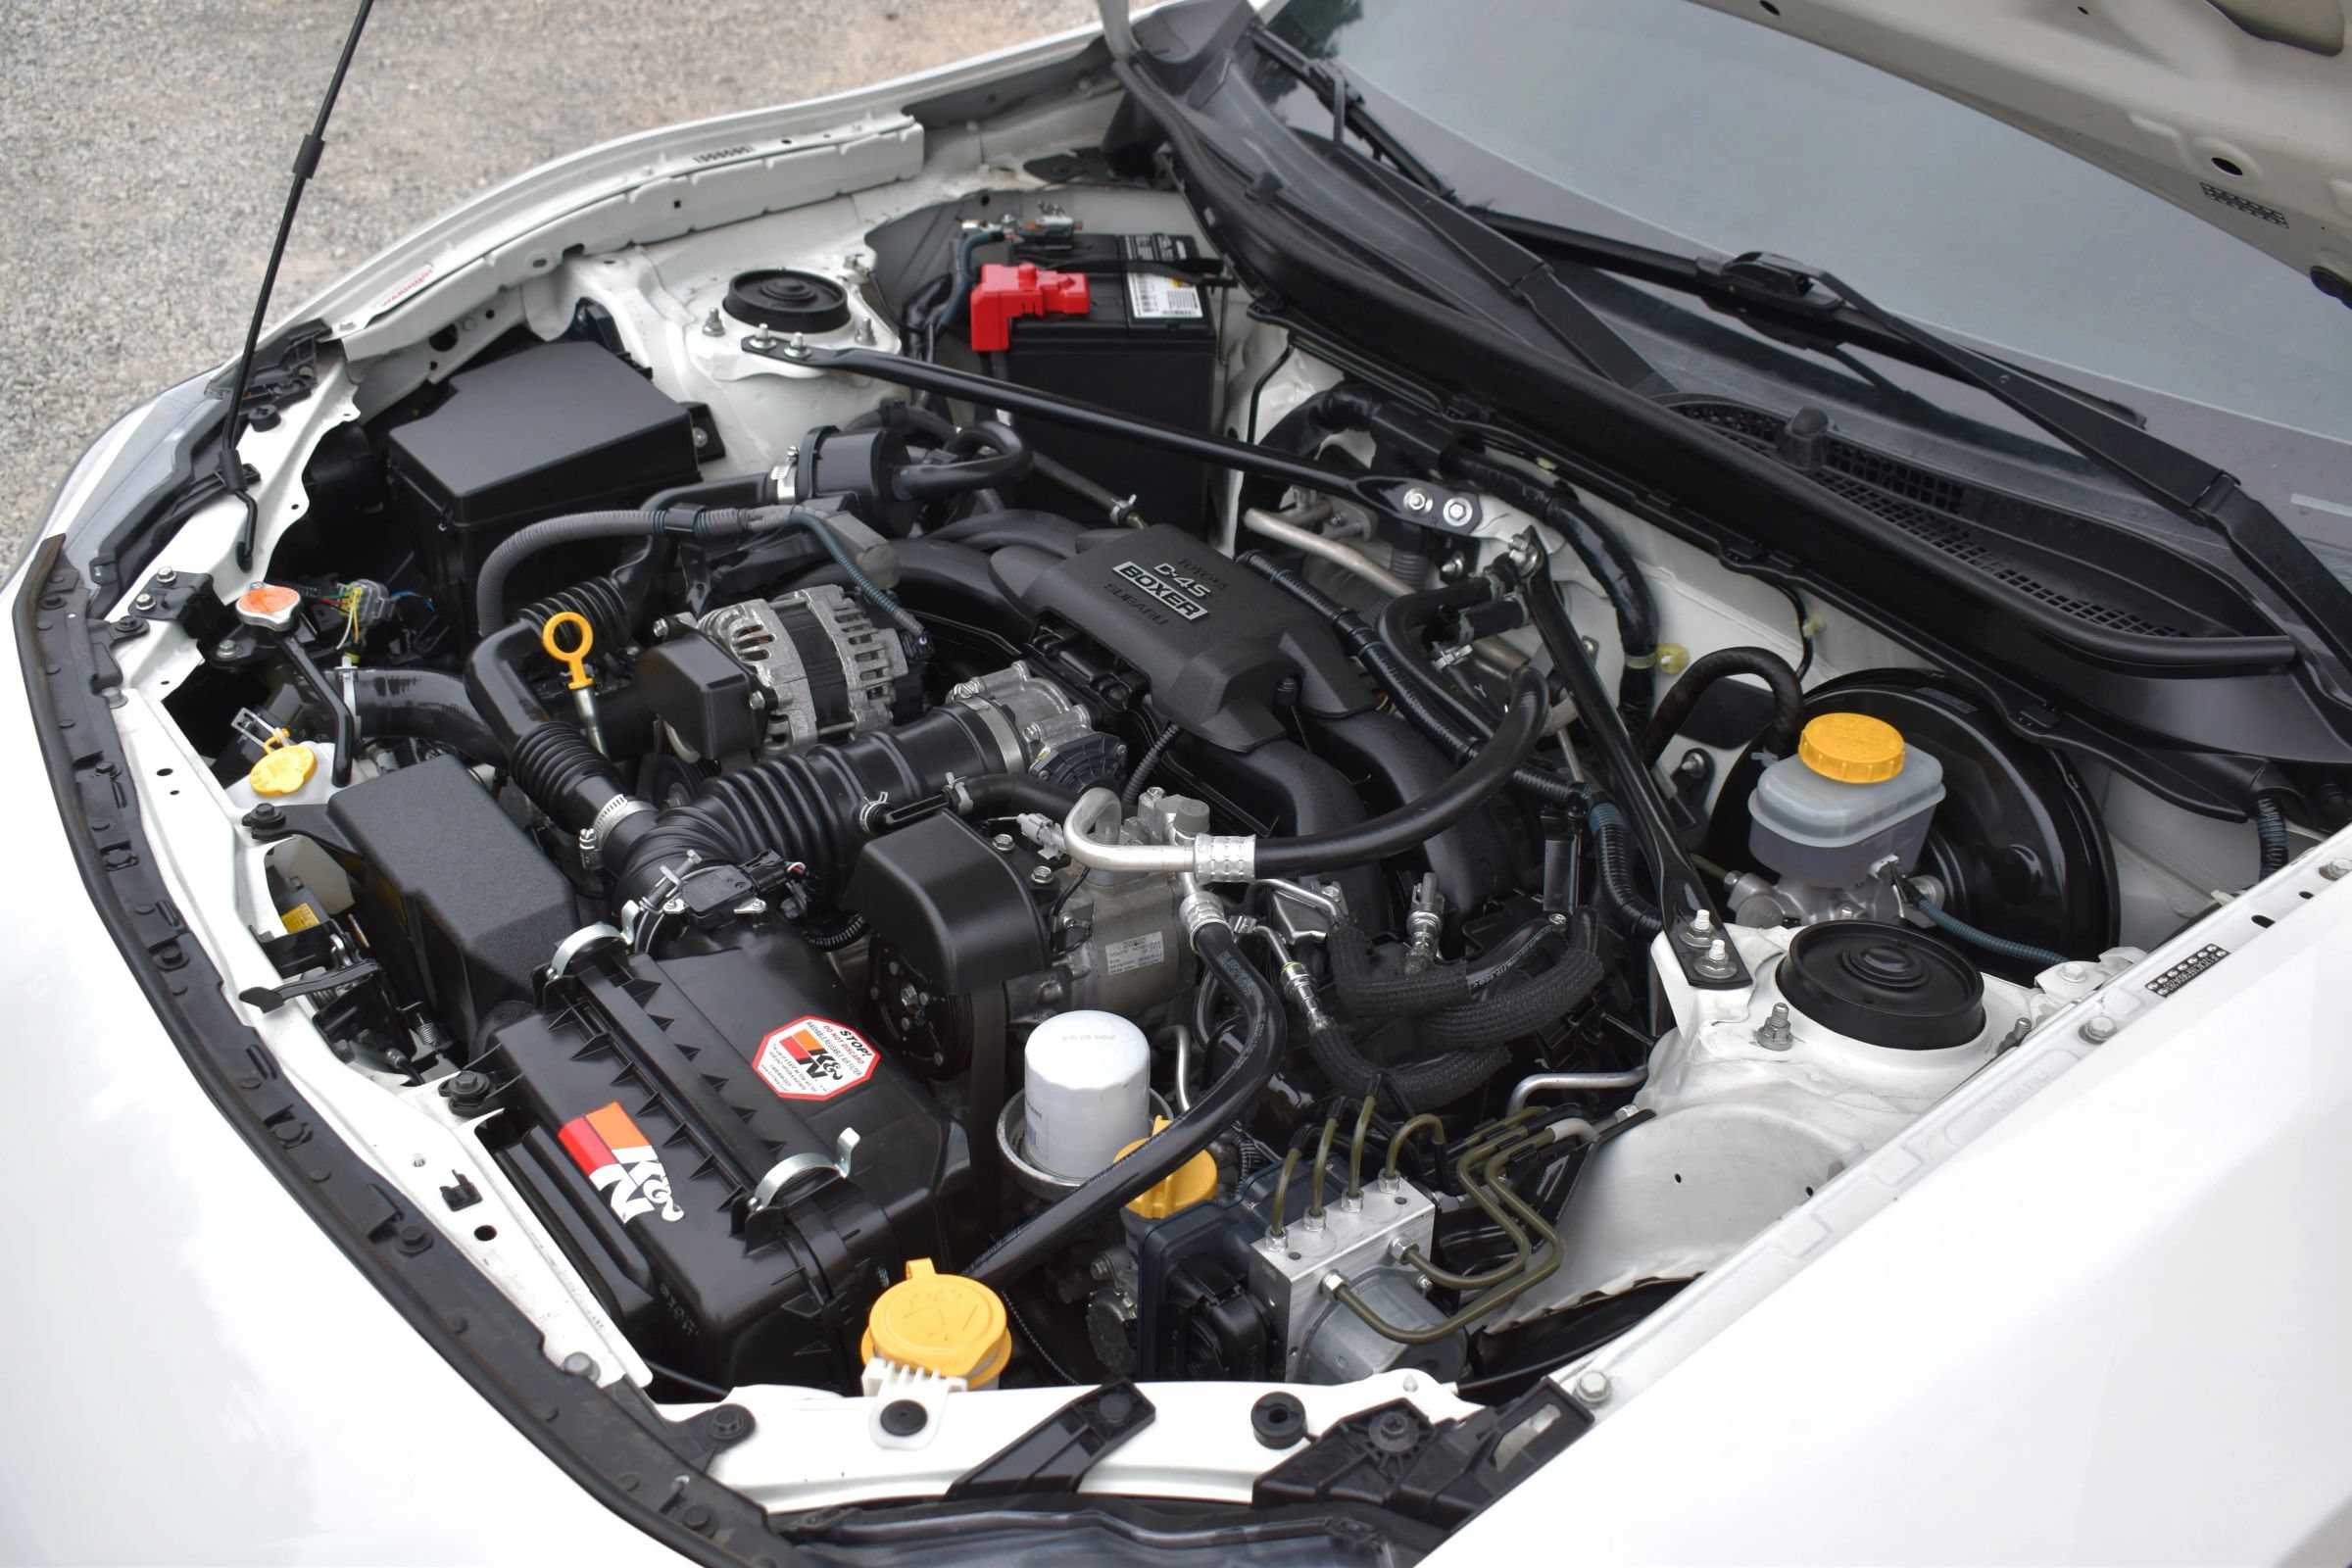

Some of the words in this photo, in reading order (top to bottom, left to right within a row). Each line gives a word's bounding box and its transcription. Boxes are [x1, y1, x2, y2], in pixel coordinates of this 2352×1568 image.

[1119, 564, 1200, 616] BOXER
[1153, 563, 1211, 597] D-4S
[1178, 558, 1227, 590] TOYOTA
[1103, 583, 1168, 625] SUBARU
[830, 1032, 843, 1043] NOT
[841, 1043, 864, 1064] DISCARD
[840, 1030, 872, 1055] STOP!
[847, 1063, 862, 1076] FILTER
